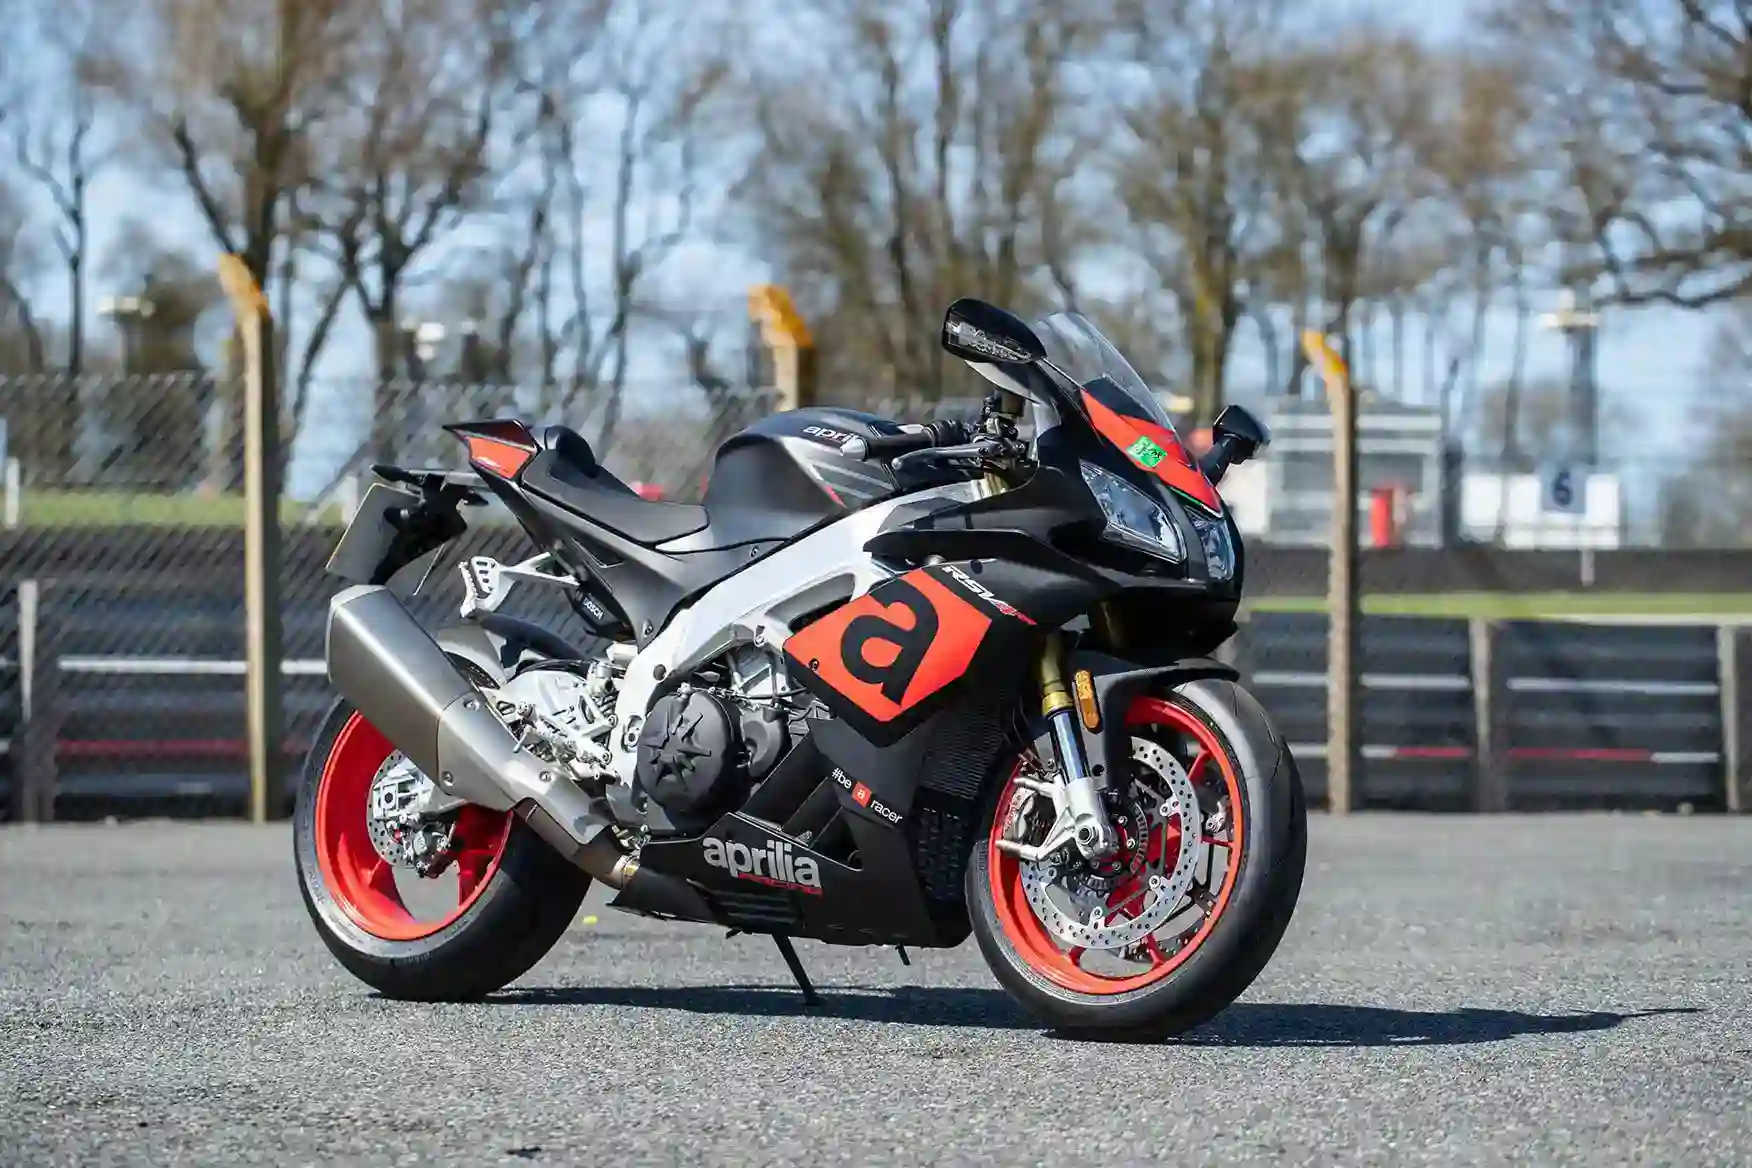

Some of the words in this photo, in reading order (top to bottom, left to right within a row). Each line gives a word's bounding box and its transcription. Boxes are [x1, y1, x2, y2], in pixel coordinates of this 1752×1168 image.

[1553, 469, 1573, 507] 6
[832, 768, 852, 789] #be
[870, 800, 903, 824] racer
[702, 837, 822, 888] aprilia
